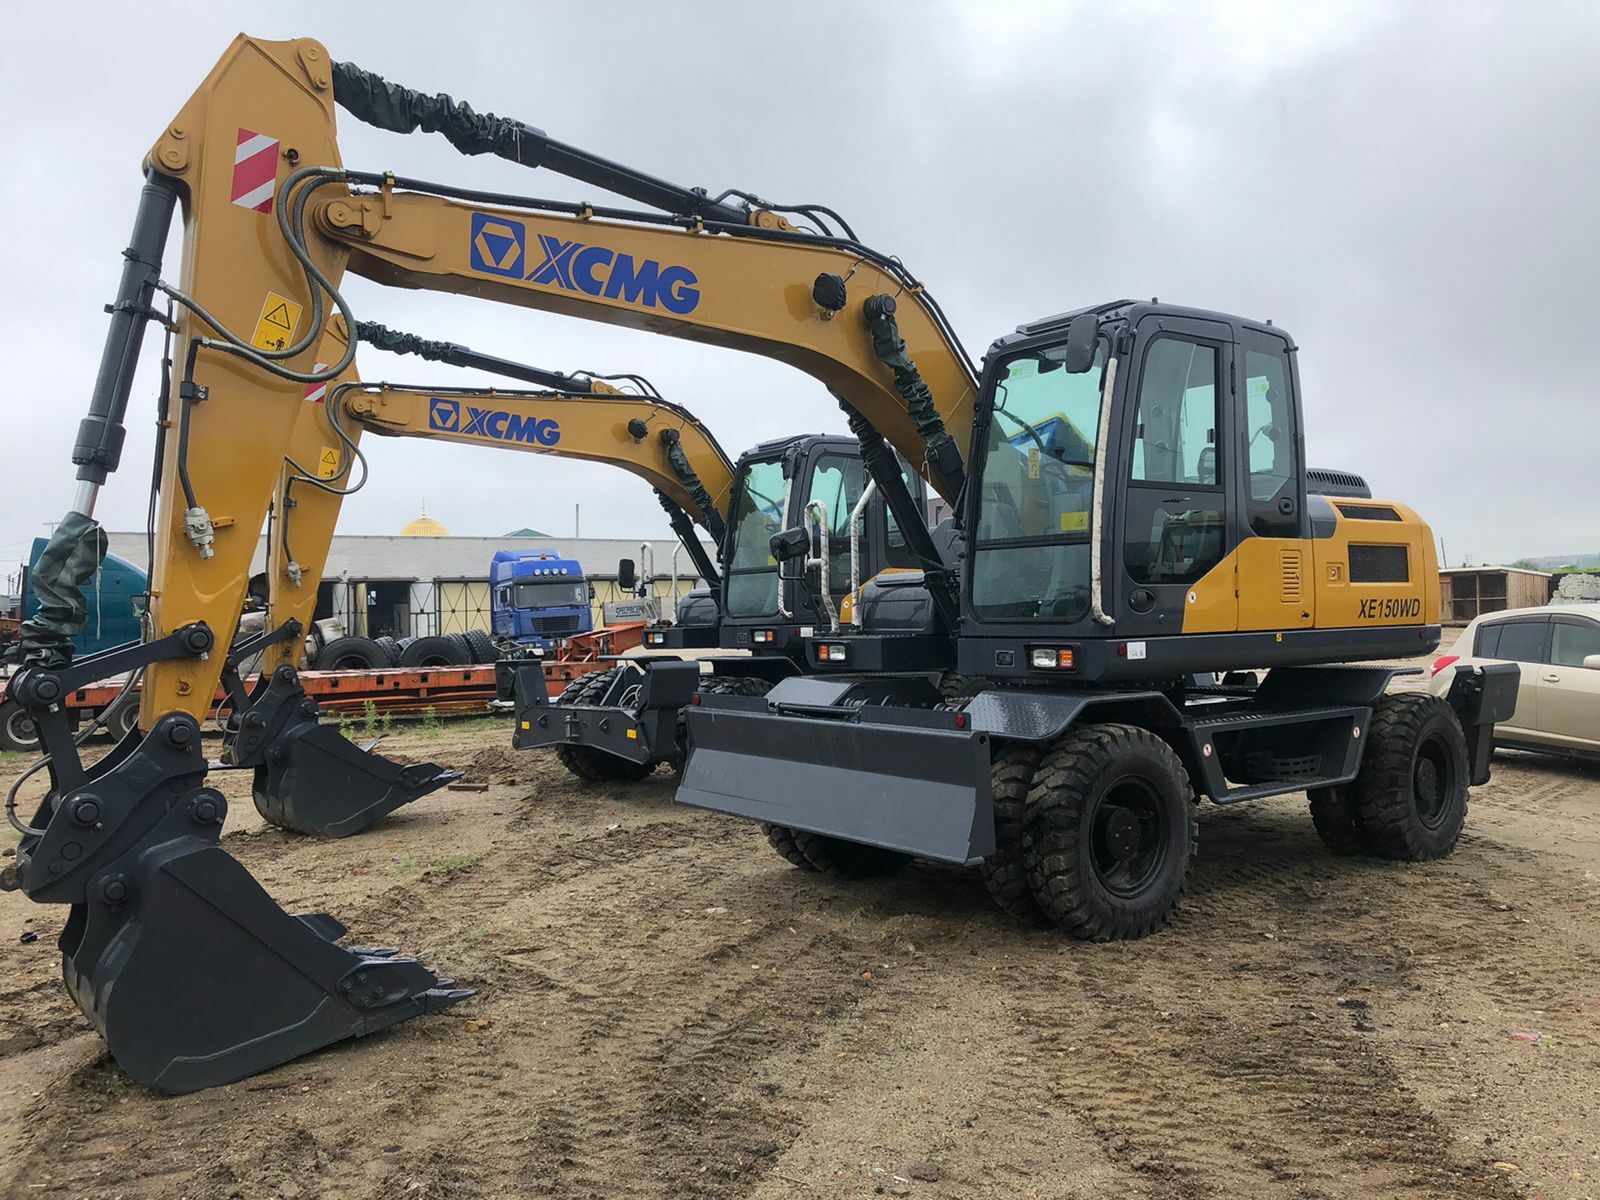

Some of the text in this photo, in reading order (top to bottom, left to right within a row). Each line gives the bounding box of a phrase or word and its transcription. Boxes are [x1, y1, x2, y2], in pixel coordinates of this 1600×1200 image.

[524, 233, 700, 315] XCMG
[460, 406, 560, 446] XCMG
[1358, 599, 1421, 619] XE150WD
